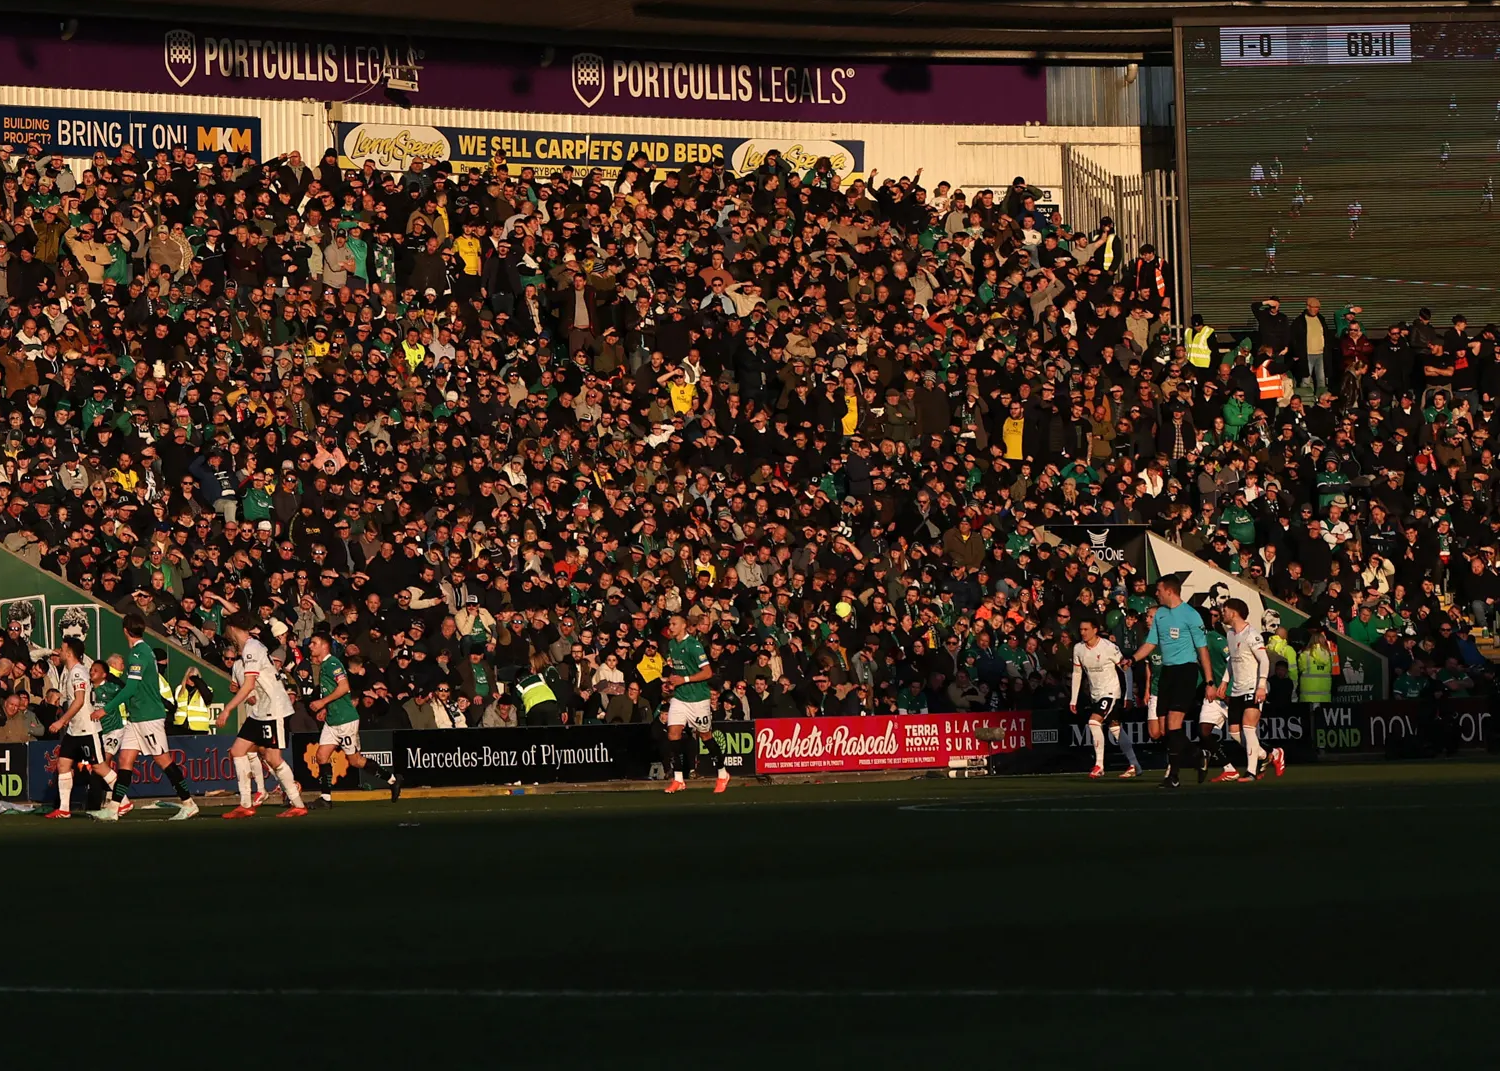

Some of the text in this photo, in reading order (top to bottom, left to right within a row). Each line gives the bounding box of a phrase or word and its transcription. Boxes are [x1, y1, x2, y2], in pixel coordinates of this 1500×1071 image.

[1239, 32, 1395, 57] 1-0 68:11
[204, 37, 338, 83] PORTCULLIS
[613, 59, 752, 102] PORTCULLIS
[3, 117, 50, 131] BUILDING
[3, 131, 51, 145] PROJECT?
[57, 119, 188, 151] BRING IT ON!
[197, 126, 252, 154] MKM
[458, 134, 487, 156] WE
[490, 136, 532, 159] SELL
[535, 138, 623, 162] CARPETS
[627, 141, 669, 162] AND
[674, 143, 724, 164] BEDS
[1099, 699, 1108, 710] 9
[695, 715, 709, 726] 40
[1323, 707, 1352, 726] WH
[904, 724, 939, 737] TERRA
[945, 718, 1026, 734] BLACK CAT
[106, 738, 119, 748] 29
[144, 734, 157, 746] 11
[339, 735, 352, 747] 20
[757, 722, 825, 759] Rockets
[905, 736, 940, 747] NOVA
[946, 736, 1026, 751] SURF CLUB
[1316, 727, 1361, 748] BOND
[406, 744, 518, 769] Mercedes-Benz
[521, 744, 538, 766] of
[539, 741, 614, 770] Plymouth.
